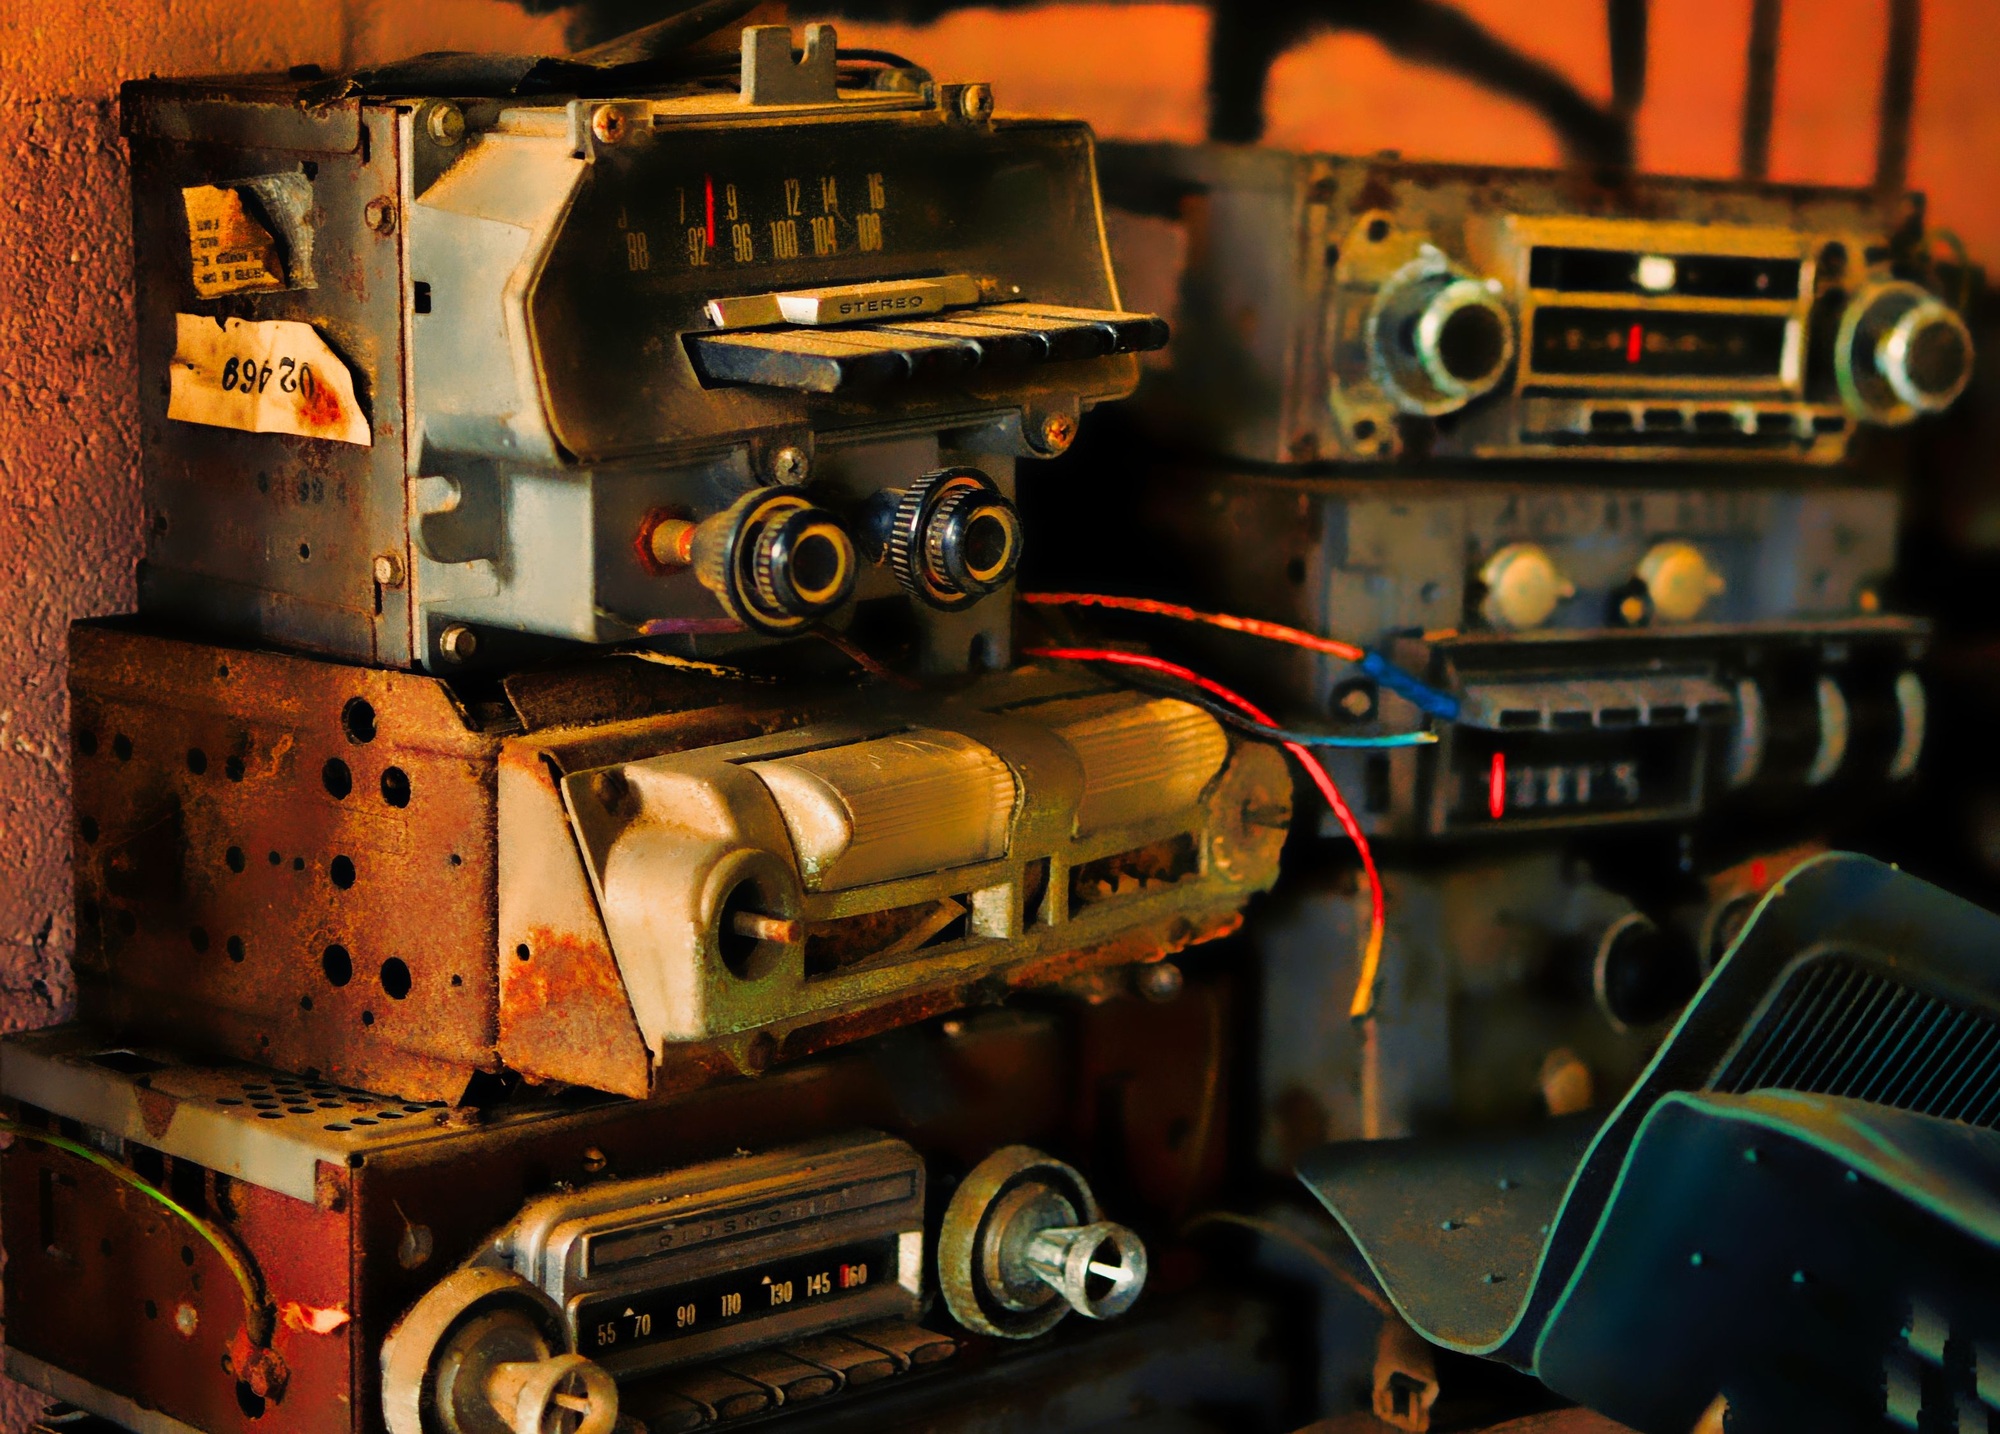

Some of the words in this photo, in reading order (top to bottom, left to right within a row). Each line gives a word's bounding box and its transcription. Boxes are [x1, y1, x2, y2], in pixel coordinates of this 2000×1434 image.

[675, 186, 685, 225] 7
[726, 184, 738, 221] 9
[784, 178, 801, 216] 12
[820, 175, 838, 213] 14
[867, 172, 885, 210] 16
[626, 232, 649, 271] 88
[687, 227, 708, 266] 92
[731, 222, 753, 262] 96
[770, 219, 798, 260] 100
[811, 215, 837, 255] 104
[856, 212, 883, 251] 108
[839, 295, 924, 315] STEREO
[659, 1189, 849, 1247] OLDSMOBI
[597, 1321, 616, 1346] 55
[634, 1313, 651, 1337] 70
[676, 1303, 696, 1328] 90
[721, 1292, 742, 1317] 110
[770, 1280, 793, 1307] 130
[806, 1271, 831, 1297] 145
[844, 1263, 867, 1288] 160
